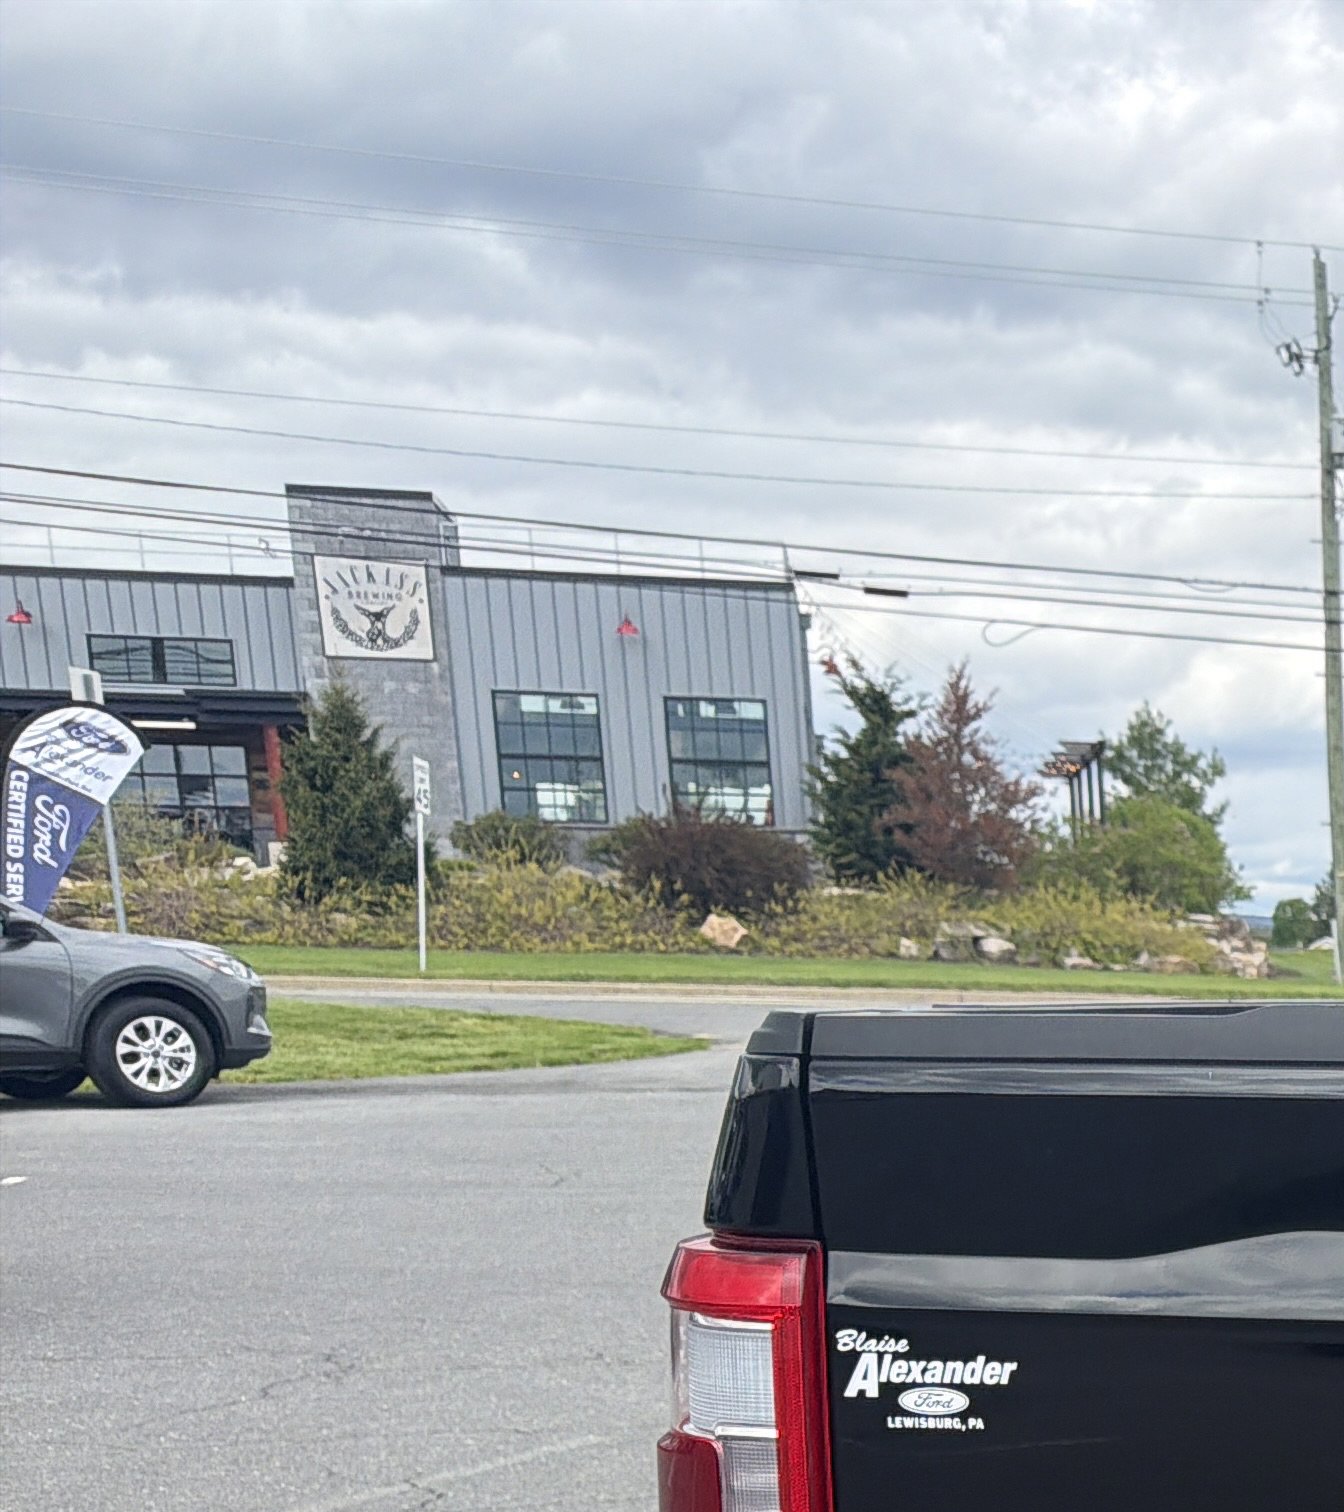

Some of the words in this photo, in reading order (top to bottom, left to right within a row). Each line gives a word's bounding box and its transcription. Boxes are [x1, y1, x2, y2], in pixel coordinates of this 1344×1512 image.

[347, 590, 402, 600] BREWING
[416, 787, 429, 809] 45
[7, 769, 30, 859] CERTIFIED
[33, 794, 70, 869] Ford
[835, 1329, 910, 1352] Blaise
[844, 1352, 1018, 1398] Alexander
[914, 1392, 954, 1409] Ford
[887, 1416, 967, 1432] LEWISBURG,
[969, 1417, 985, 1430] PA
